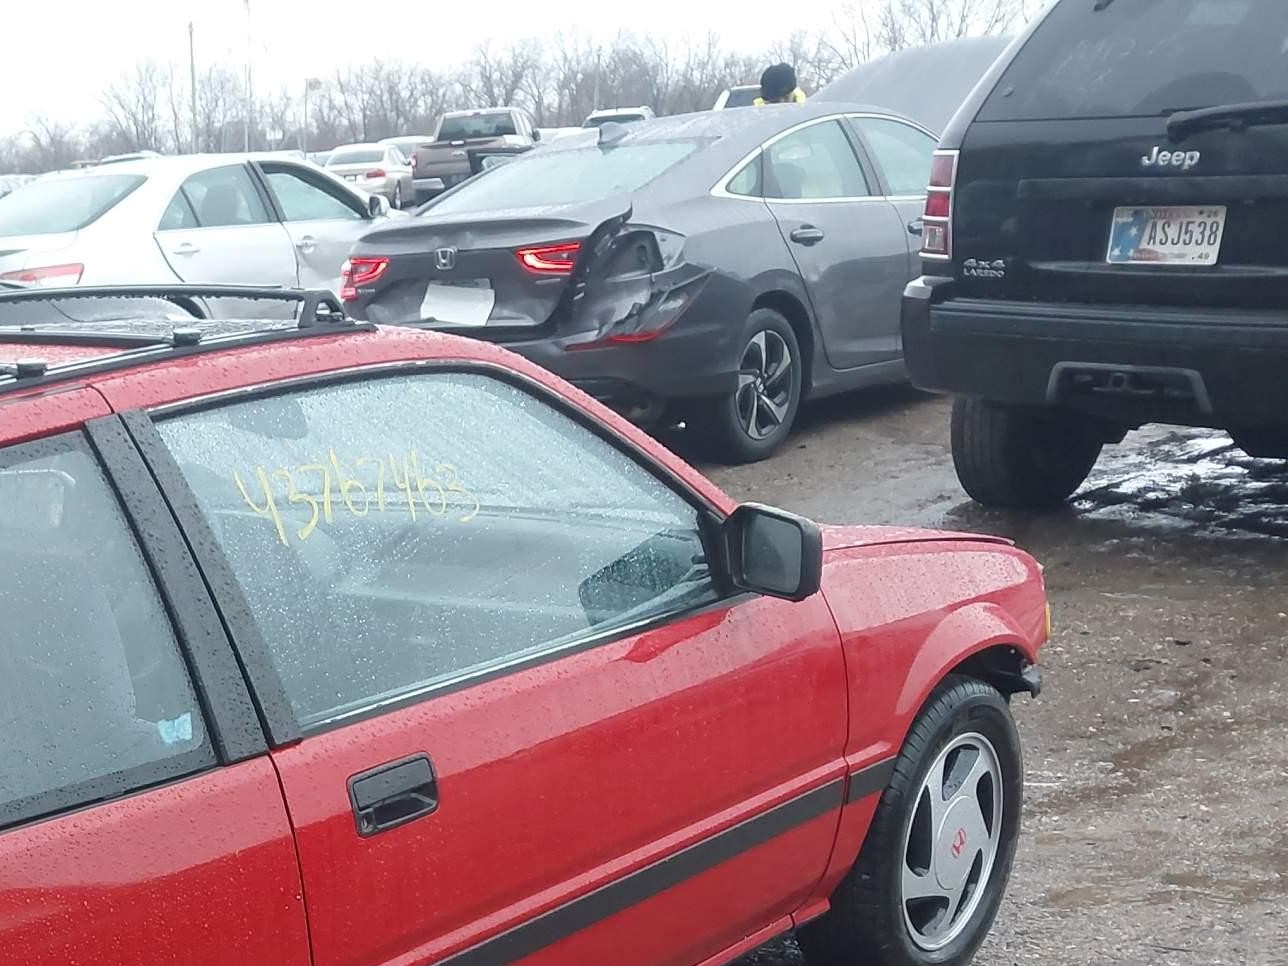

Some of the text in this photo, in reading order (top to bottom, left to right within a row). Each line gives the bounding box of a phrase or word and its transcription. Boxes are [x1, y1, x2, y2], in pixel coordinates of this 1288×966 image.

[1141, 146, 1200, 170] Jeep
[1146, 220, 1220, 246] ASJ538
[232, 448, 480, 547] 43767463
